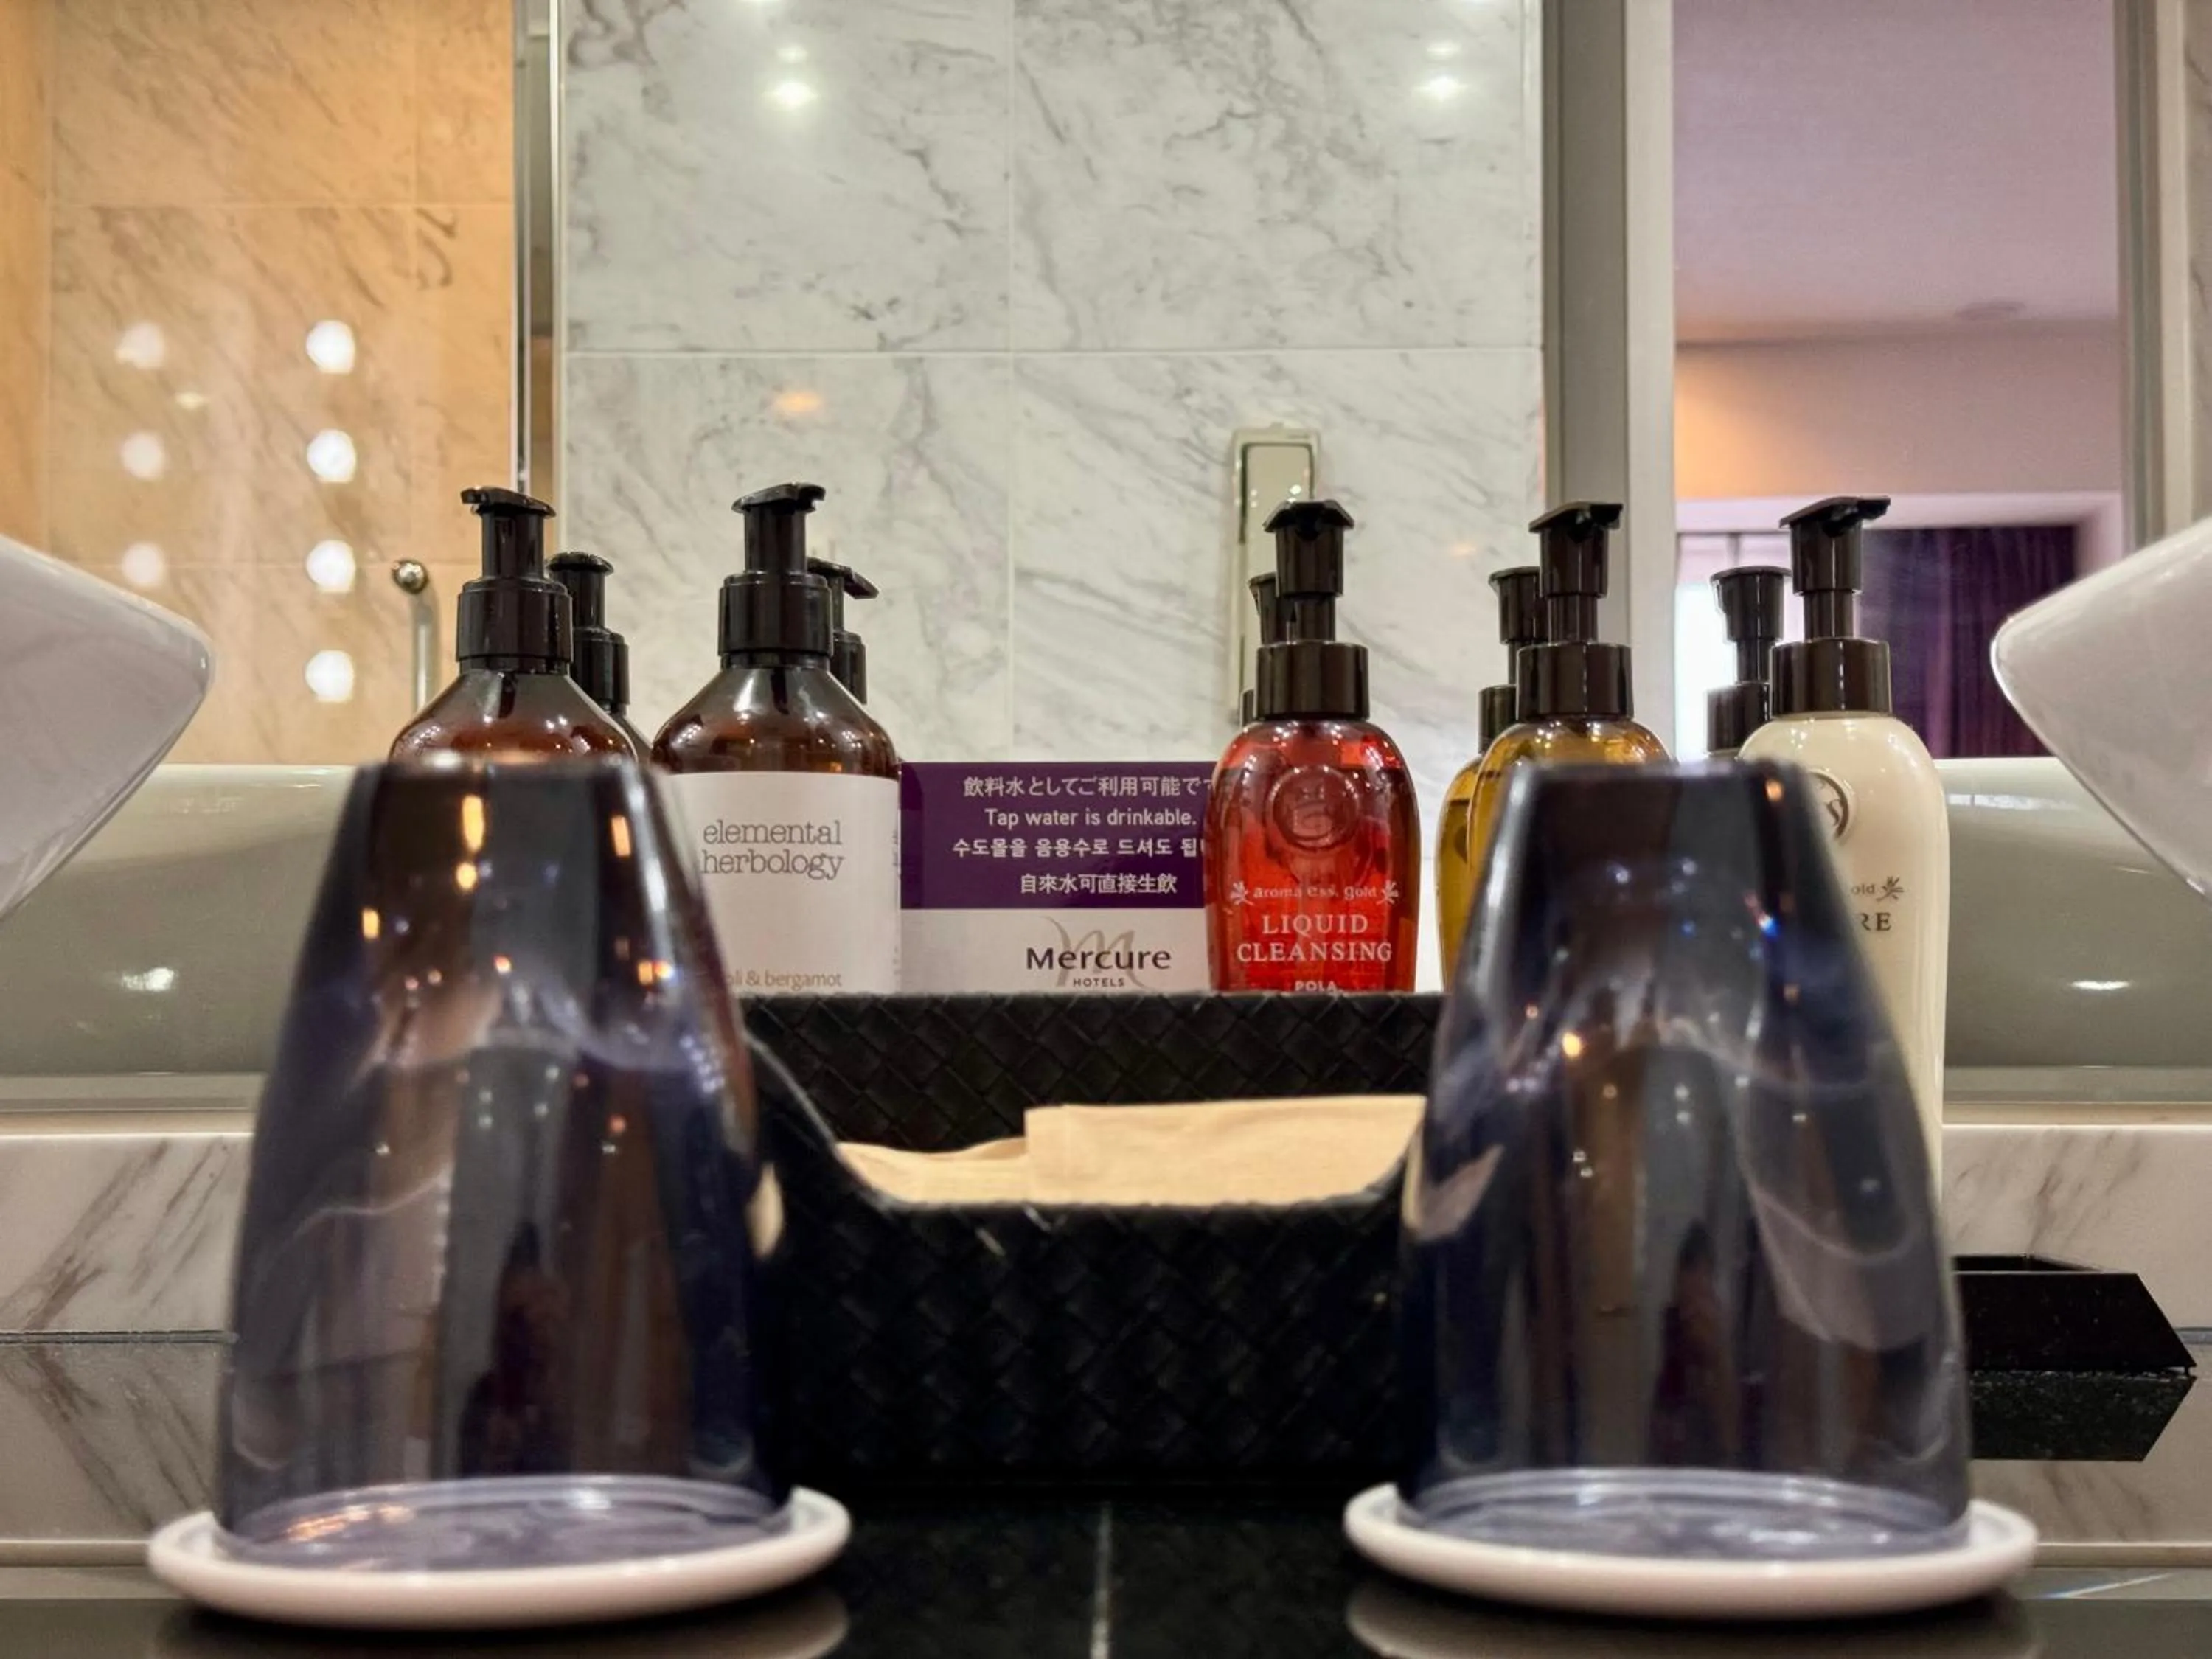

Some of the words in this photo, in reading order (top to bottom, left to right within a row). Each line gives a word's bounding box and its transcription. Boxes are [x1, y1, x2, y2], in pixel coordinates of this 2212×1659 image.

[984, 807, 1019, 830] Tap
[1025, 809, 1079, 826] water
[1085, 807, 1101, 826] is
[1107, 807, 1197, 826] drinkable.
[703, 819, 843, 845] elemental
[1116, 838, 1173, 858] 드셔도
[700, 849, 846, 880] herbology
[1020, 874, 1178, 894] 自來水可直接生飲
[1254, 886, 1301, 897] aroma
[1344, 886, 1377, 900] gold
[1851, 883, 1876, 895] old
[1262, 914, 1368, 937] LIQUID
[1026, 946, 1172, 970] Mercure
[1237, 942, 1392, 962] CLEANSING
[745, 970, 762, 987] &
[765, 970, 842, 991] bergamot
[1073, 978, 1124, 987] HOTELS
[1295, 980, 1338, 993] POLA
